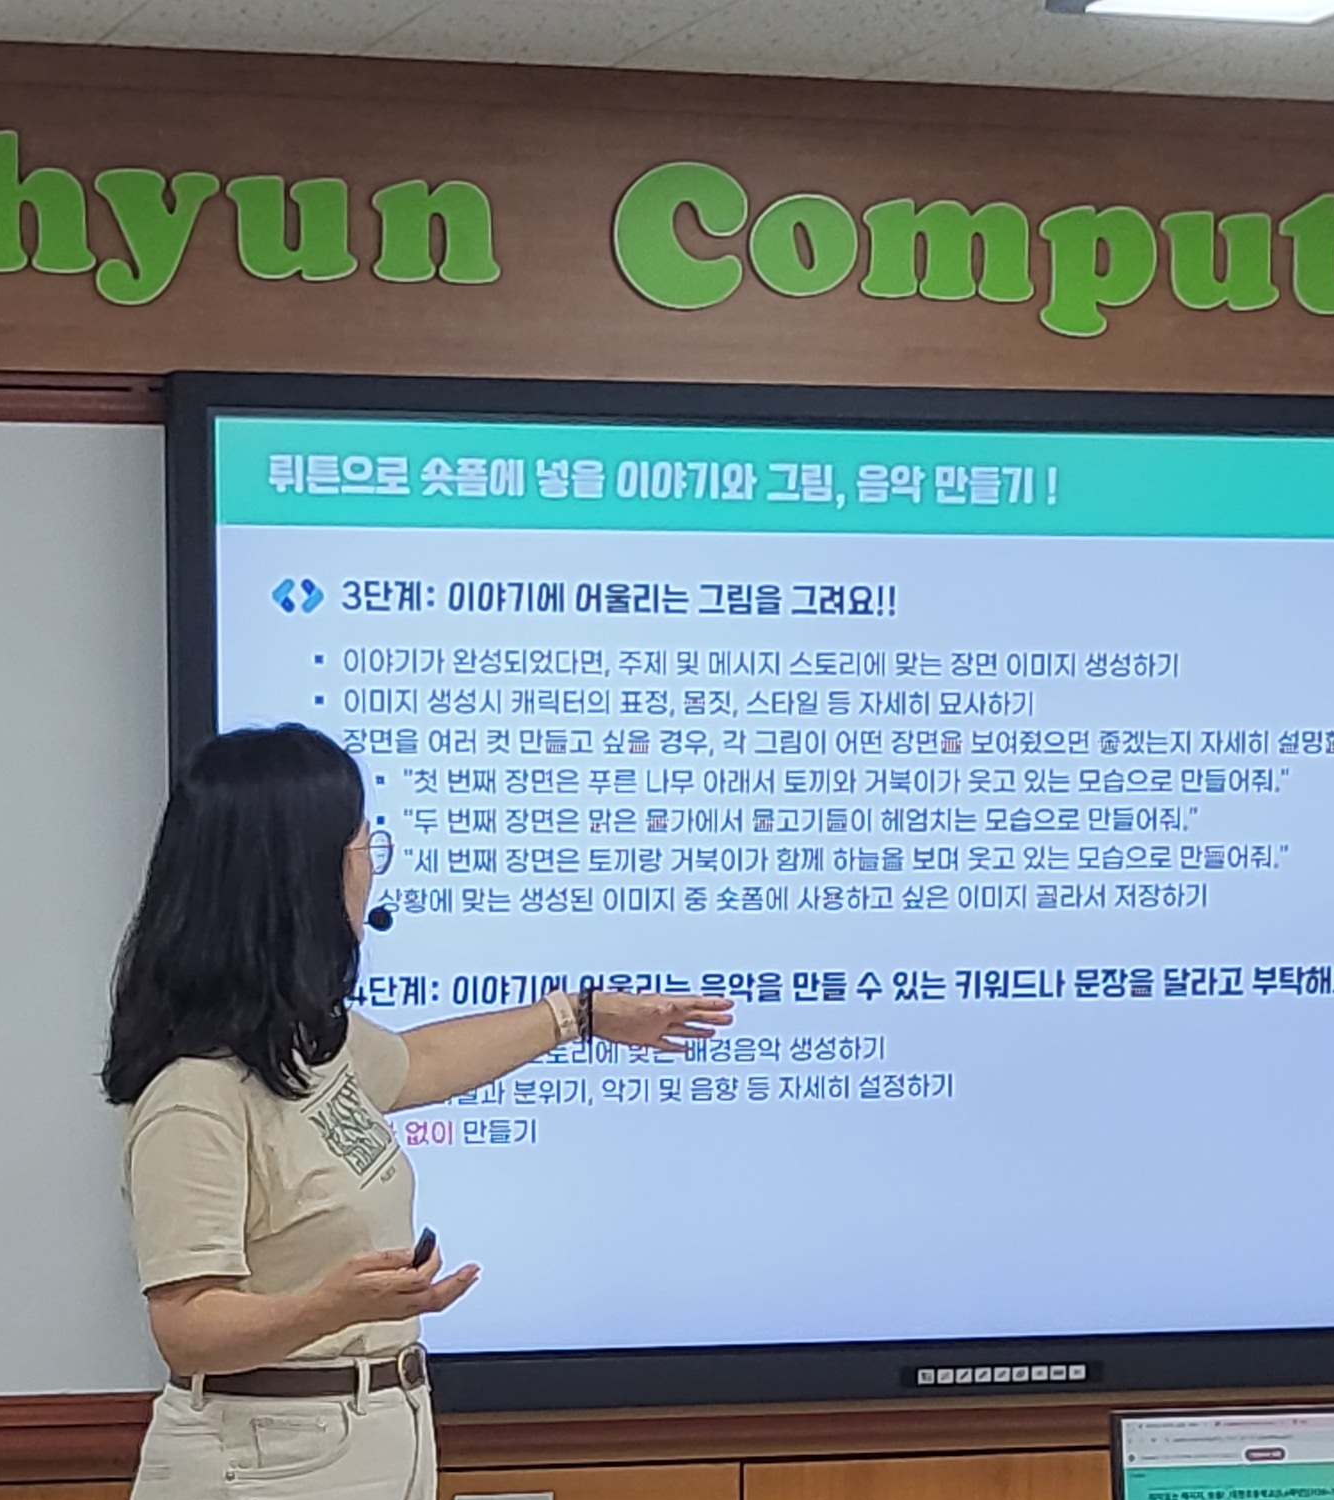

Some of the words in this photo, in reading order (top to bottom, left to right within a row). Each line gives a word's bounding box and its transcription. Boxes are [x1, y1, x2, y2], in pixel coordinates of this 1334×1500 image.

[269, 455, 410, 494] 뤼튼으로
[421, 458, 523, 496] 숏폼에
[537, 460, 605, 498] 넣을
[617, 461, 757, 499] 이야기와
[767, 464, 845, 509] 그림,
[857, 465, 925, 503] 음악
[936, 466, 1033, 504] 만들기
[342, 581, 434, 611] 3단계:
[448, 582, 564, 612] 이야기에
[576, 583, 689, 614] 어울리는
[699, 584, 782, 615] 그림을
[792, 586, 895, 616] 그려요!!
[344, 648, 444, 673] 이야기가
[453, 649, 610, 677] 완성되었다면,
[619, 651, 666, 675] 주제
[678, 651, 698, 675] 및
[709, 651, 779, 676] 메시지
[790, 652, 885, 676] 스토리에
[896, 652, 942, 676] 맞는
[952, 653, 996, 676] 장면
[1007, 653, 1075, 677] 이미지
[1085, 653, 1178, 677] 생성하기
[345, 689, 417, 714] 이미지
[428, 689, 501, 714] 생성시
[512, 690, 609, 714] 캐릭터의
[620, 691, 674, 717] 표정,
[684, 691, 738, 717] 몸짓,
[747, 691, 818, 715] 스타일
[828, 691, 850, 715] 등
[859, 691, 929, 716] 자세히
[939, 691, 1032, 716] 묘사하기
[341, 729, 418, 756] 장면을
[429, 729, 476, 754] 여러
[487, 729, 509, 754] 컷
[520, 729, 593, 754] 만들고
[603, 730, 650, 754] 싶을
[660, 730, 713, 757] 경우,
[723, 730, 746, 754] 각
[755, 730, 825, 755] 그림이
[836, 730, 882, 754] 어떤
[892, 730, 962, 754] 장면을
[971, 730, 1089, 754] 보여줬으면
[1098, 730, 1190, 754] 좋겠는지
[1201, 730, 1268, 754] 자세히
[448, 769, 496, 794] 번째
[506, 769, 579, 793] 장면은
[589, 769, 637, 794] 푸른
[647, 769, 694, 794] 나무
[704, 769, 774, 794] 아래서
[784, 769, 856, 794] 토끼와
[866, 769, 961, 794] 거북이가
[969, 769, 1015, 793] 웃고
[1025, 769, 1070, 793] 있는
[1079, 769, 1172, 793] 모습으로
[448, 809, 496, 833] 번째
[506, 809, 579, 833] 장면은
[589, 809, 637, 833] 맑은
[646, 808, 742, 833] 물가에서
[753, 808, 871, 832] 물고기들이
[881, 808, 977, 832] 헤엄치는
[986, 808, 1080, 832] 모습으로
[380, 887, 453, 913] 상황에
[462, 888, 511, 912] 맞는
[520, 888, 593, 912] 생성된
[604, 887, 674, 912] 이미지
[685, 887, 707, 911] 중
[717, 886, 788, 910] 숏폼에
[797, 886, 893, 910] 사용하고
[902, 885, 948, 910] 싶은
[959, 885, 1026, 909] 이미지
[1037, 884, 1105, 908] 골라서
[1115, 884, 1206, 908] 저장하기
[700, 971, 784, 1003] 음악을
[793, 972, 847, 1001] 만들
[856, 972, 883, 1001] 수
[893, 971, 946, 1001] 있는
[955, 969, 1066, 999] 키워드나
[1074, 969, 1154, 998] 문장을
[1164, 967, 1244, 997] 달라고
[683, 1037, 781, 1063] 배경음악
[790, 1036, 884, 1061] 생성하기
[513, 1078, 593, 1106] 분위기,
[602, 1079, 648, 1102] 악기
[660, 1078, 681, 1102] 및
[691, 1077, 738, 1101] 음향
[747, 1077, 769, 1100] 등
[779, 1075, 849, 1099] 자세히
[859, 1074, 952, 1098] 설정하기
[406, 1121, 452, 1145] 없이
[464, 1119, 535, 1144] 만들기
